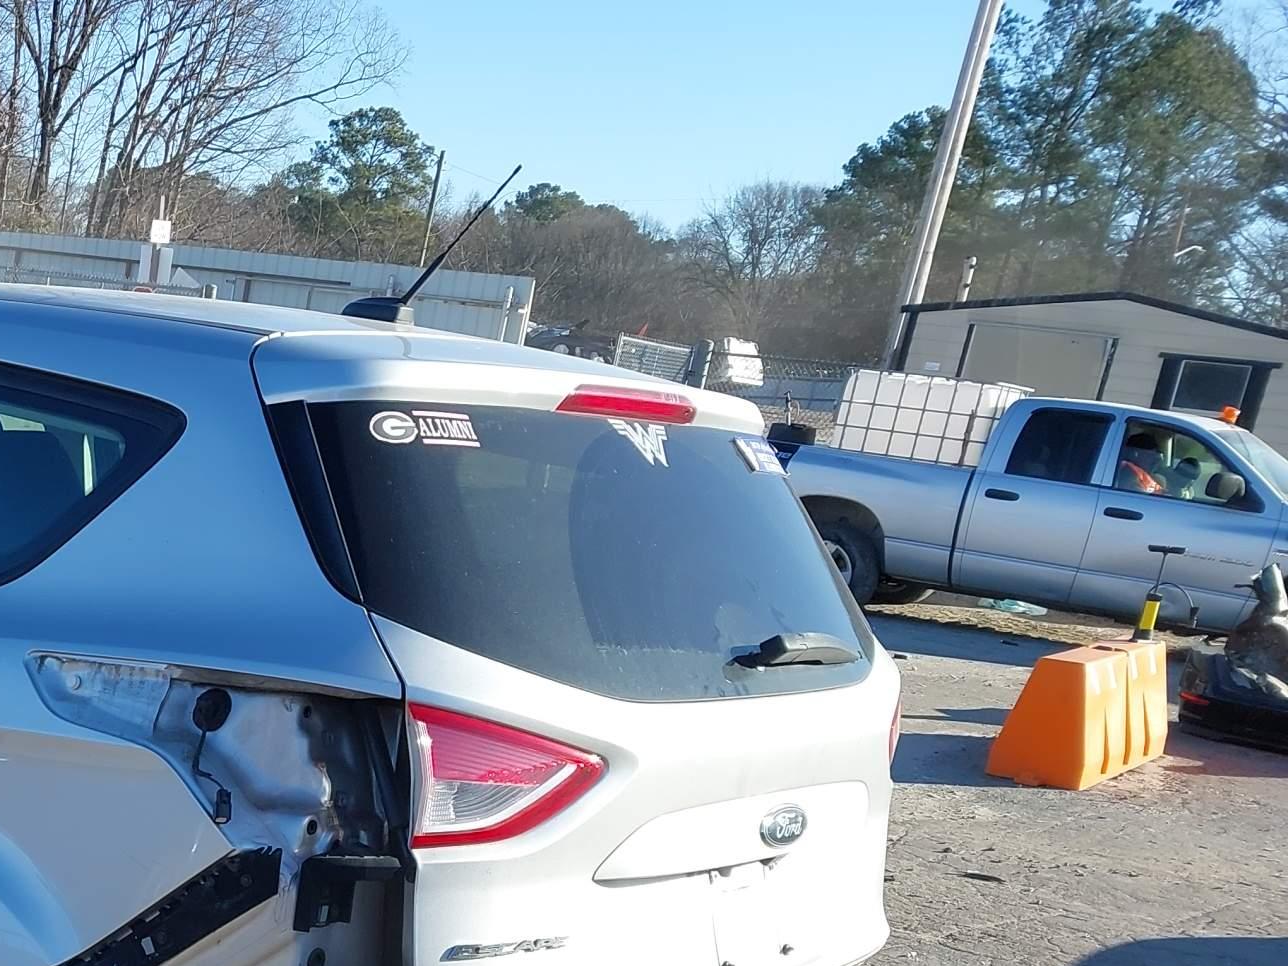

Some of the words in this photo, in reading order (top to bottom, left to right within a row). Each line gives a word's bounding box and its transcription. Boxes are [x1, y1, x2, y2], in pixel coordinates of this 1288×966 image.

[369, 410, 419, 444] G
[417, 417, 478, 440] ALUMNI
[774, 812, 803, 839] Ford
